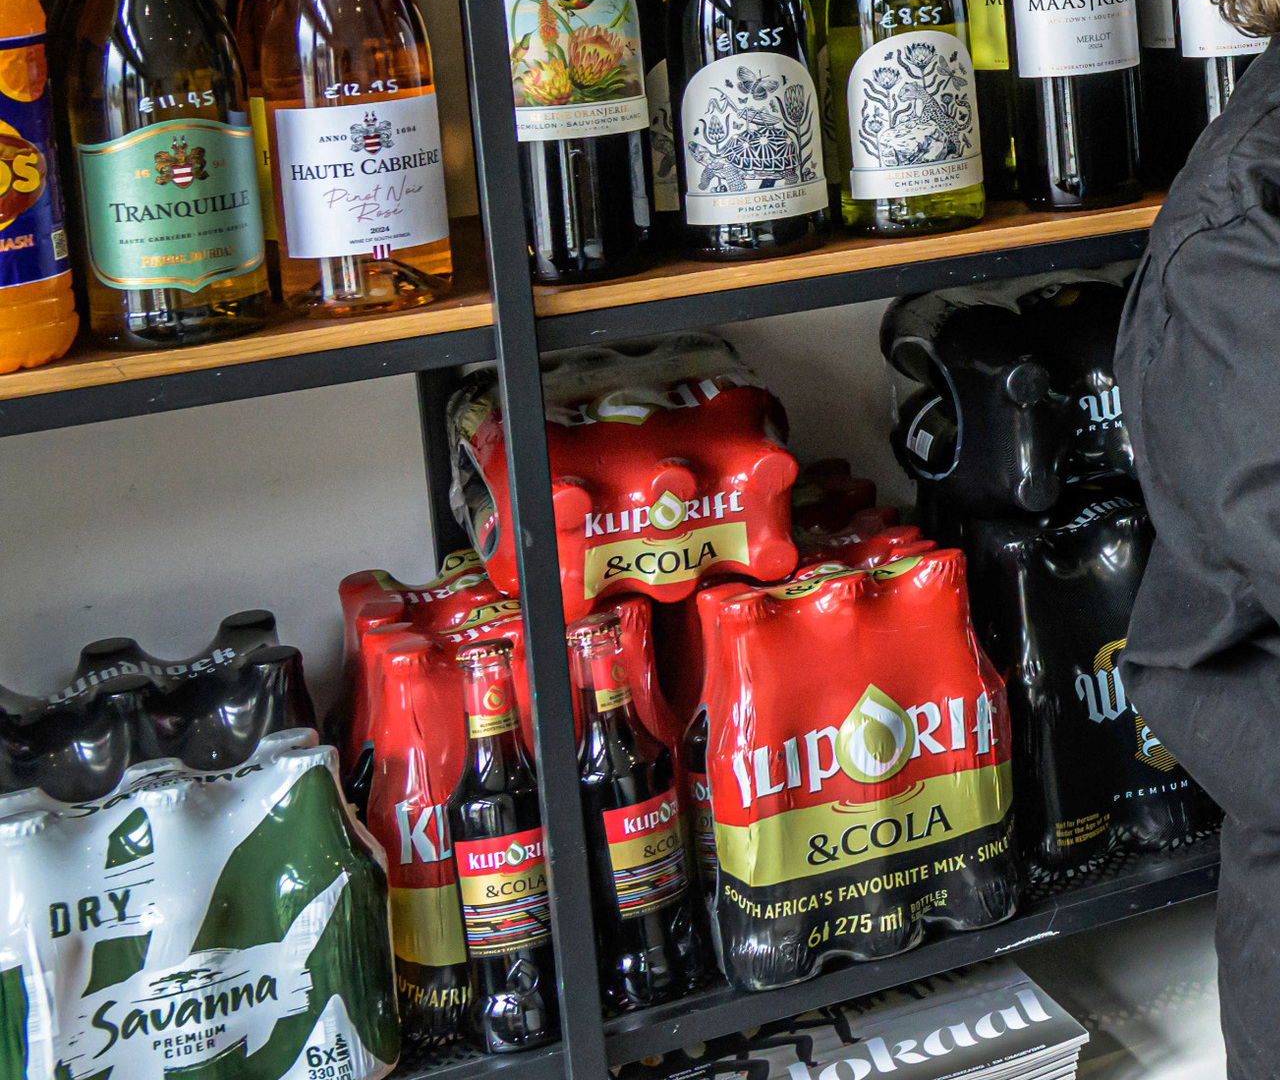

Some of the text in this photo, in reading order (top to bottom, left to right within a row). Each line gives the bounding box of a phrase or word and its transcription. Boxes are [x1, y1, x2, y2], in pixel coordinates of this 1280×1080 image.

[716, 26, 784, 51] €8.55
[1076, 32, 1112, 44] MERLOT
[530, 104, 629, 122] KLEINE ORANJERIE
[566, 116, 618, 128] SAUVIGNON
[318, 125, 417, 144] ANNO 1694
[134, 169, 151, 180] 16
[290, 147, 440, 182] HAUTE CABRIÈRE
[921, 162, 969, 177] ORANJERIE
[322, 174, 424, 209] Pinot Noir
[894, 173, 961, 189] CHENIN BLANC
[108, 189, 250, 224] TRANQUILLE
[754, 188, 807, 203] ORANJERIE
[348, 202, 404, 223] Rosé
[738, 202, 787, 213] PINOTAGE
[119, 236, 145, 246] HAUTE
[369, 225, 391, 235] 2024
[374, 234, 393, 243] SOUTH
[603, 540, 719, 580] &COLA
[1113, 779, 1189, 803] PREMIUM
[805, 804, 954, 867] &COLA
[485, 873, 547, 898] &COLA
[724, 853, 967, 920] SOUTH AFRICA'S FAVOURITE MIX
[909, 889, 948, 914] BOTTLES
[49, 888, 132, 939] DRY
[807, 906, 903, 948] 6 275 ml
[91, 974, 279, 1060] Savanna
[152, 1023, 227, 1051] PREMIUM
[163, 1037, 216, 1060] CIDER
[305, 1045, 338, 1068] 6x
[308, 1059, 353, 1080] 330 ml
